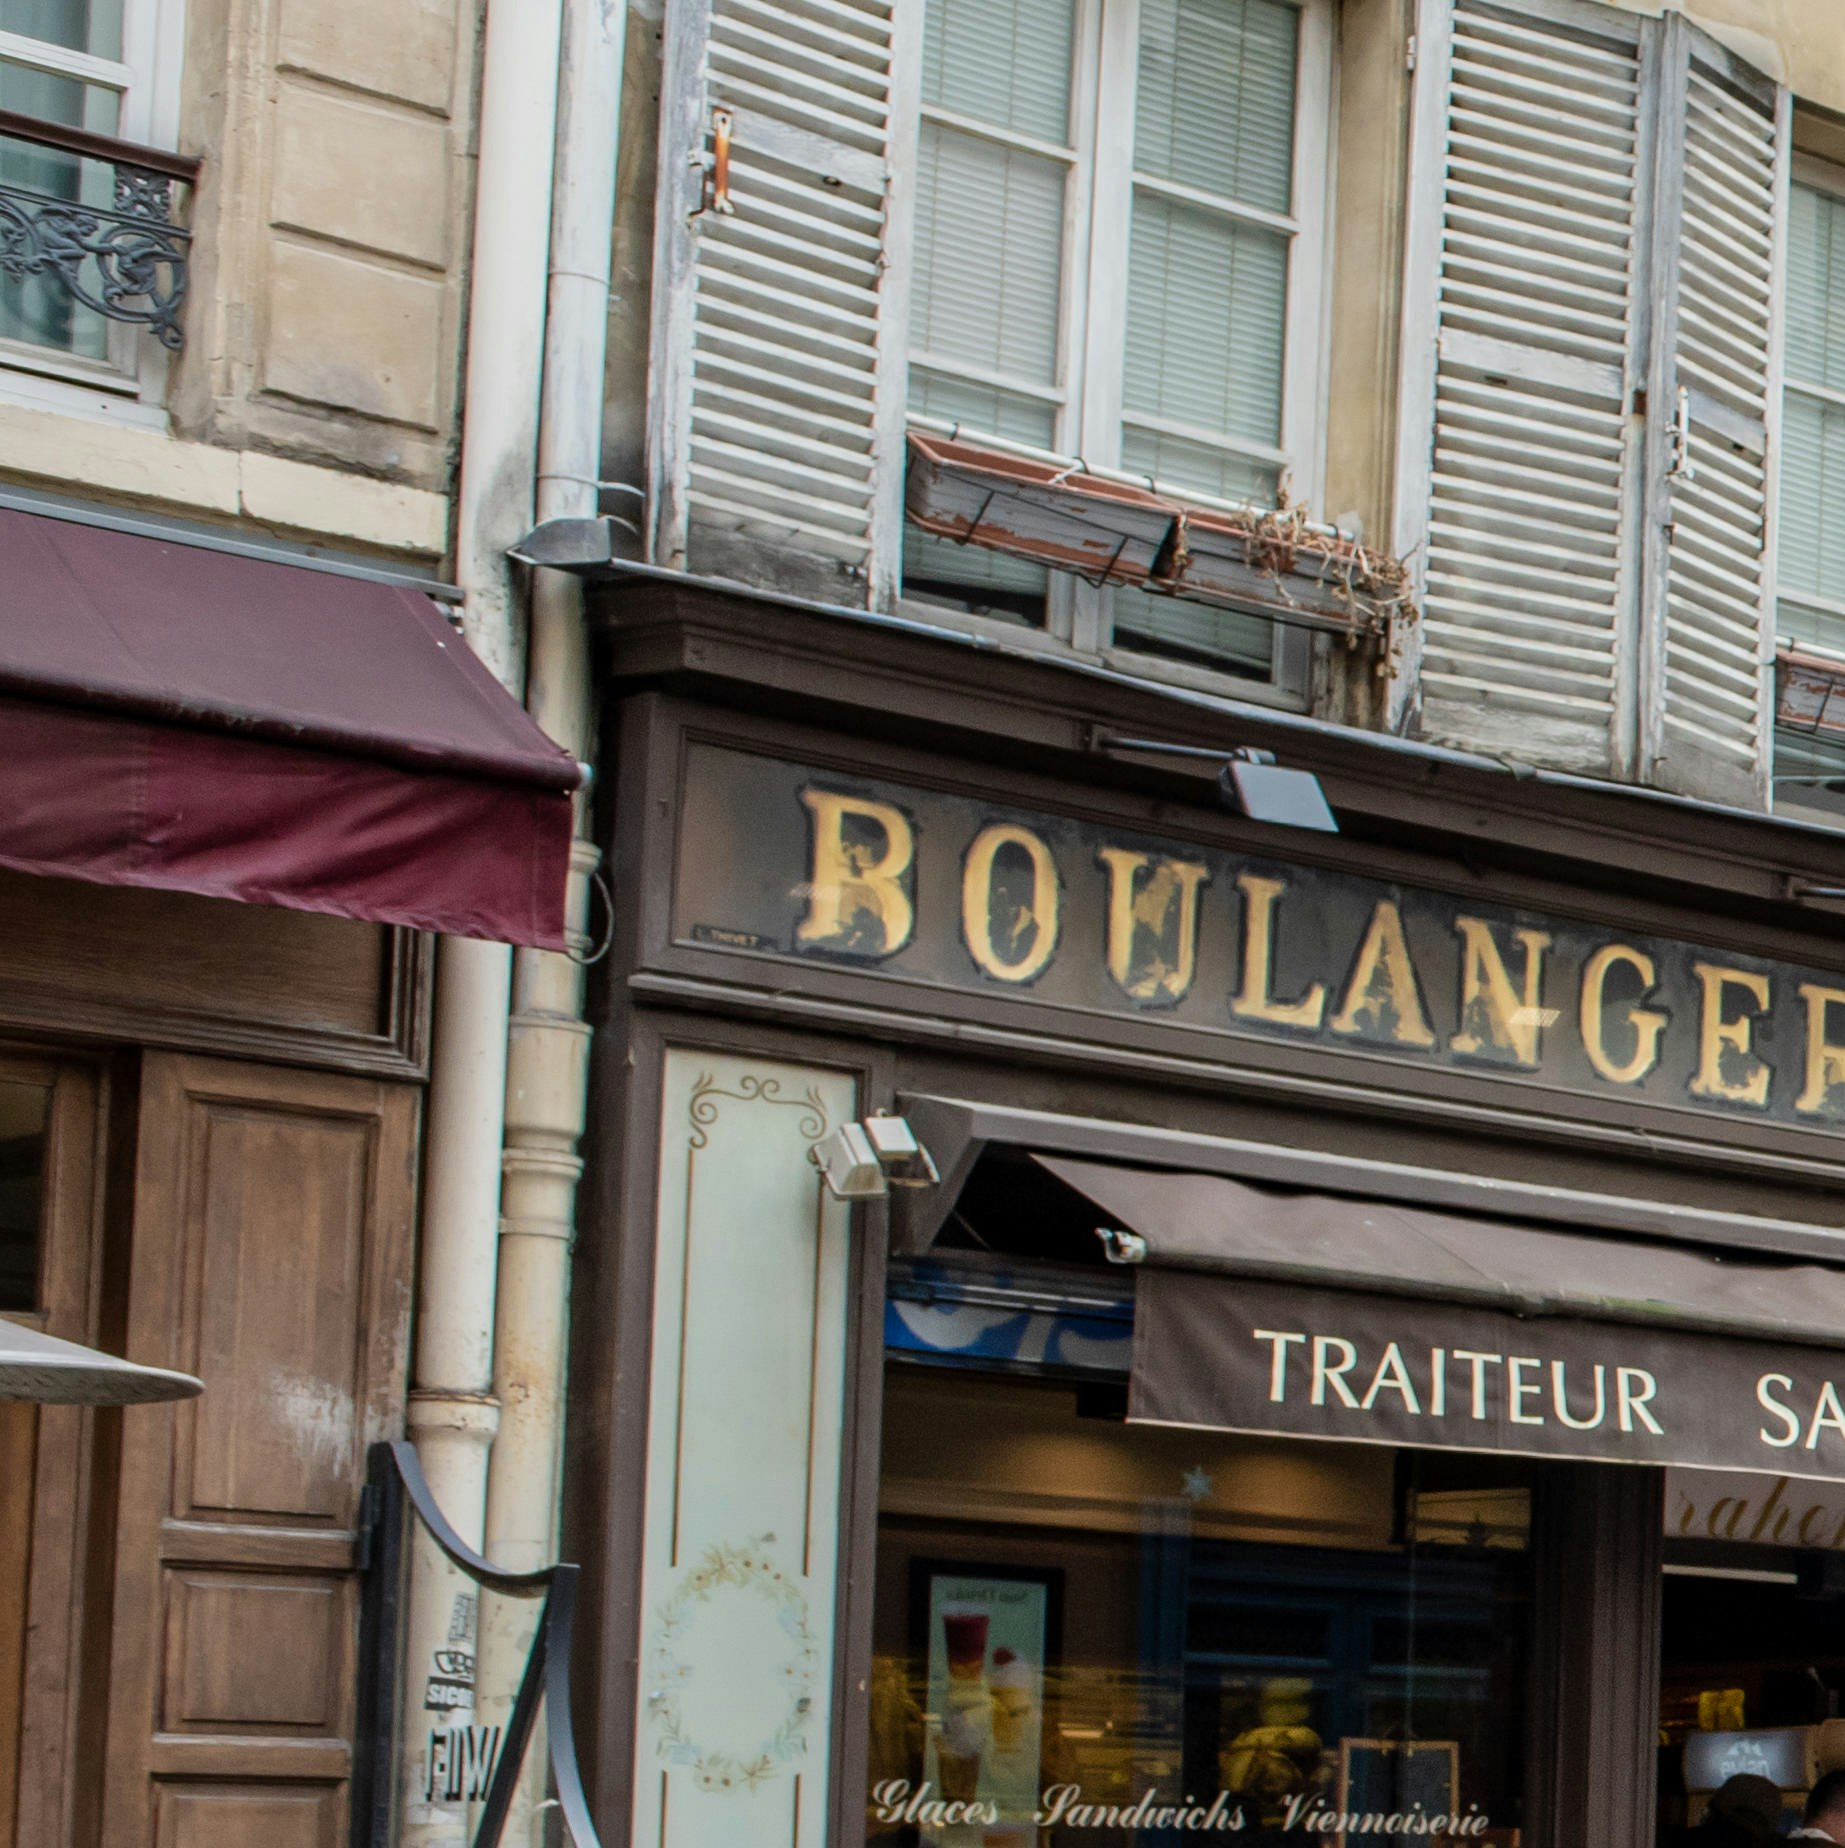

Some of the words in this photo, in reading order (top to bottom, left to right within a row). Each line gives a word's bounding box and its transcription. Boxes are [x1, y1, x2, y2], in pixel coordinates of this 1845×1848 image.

[1252, 1328, 1665, 1435] TRAITEUR
[871, 1778, 998, 1826] Glaces
[1033, 1782, 1247, 1833] Sandwichs
[1279, 1792, 1491, 1837] Viennoiserie
